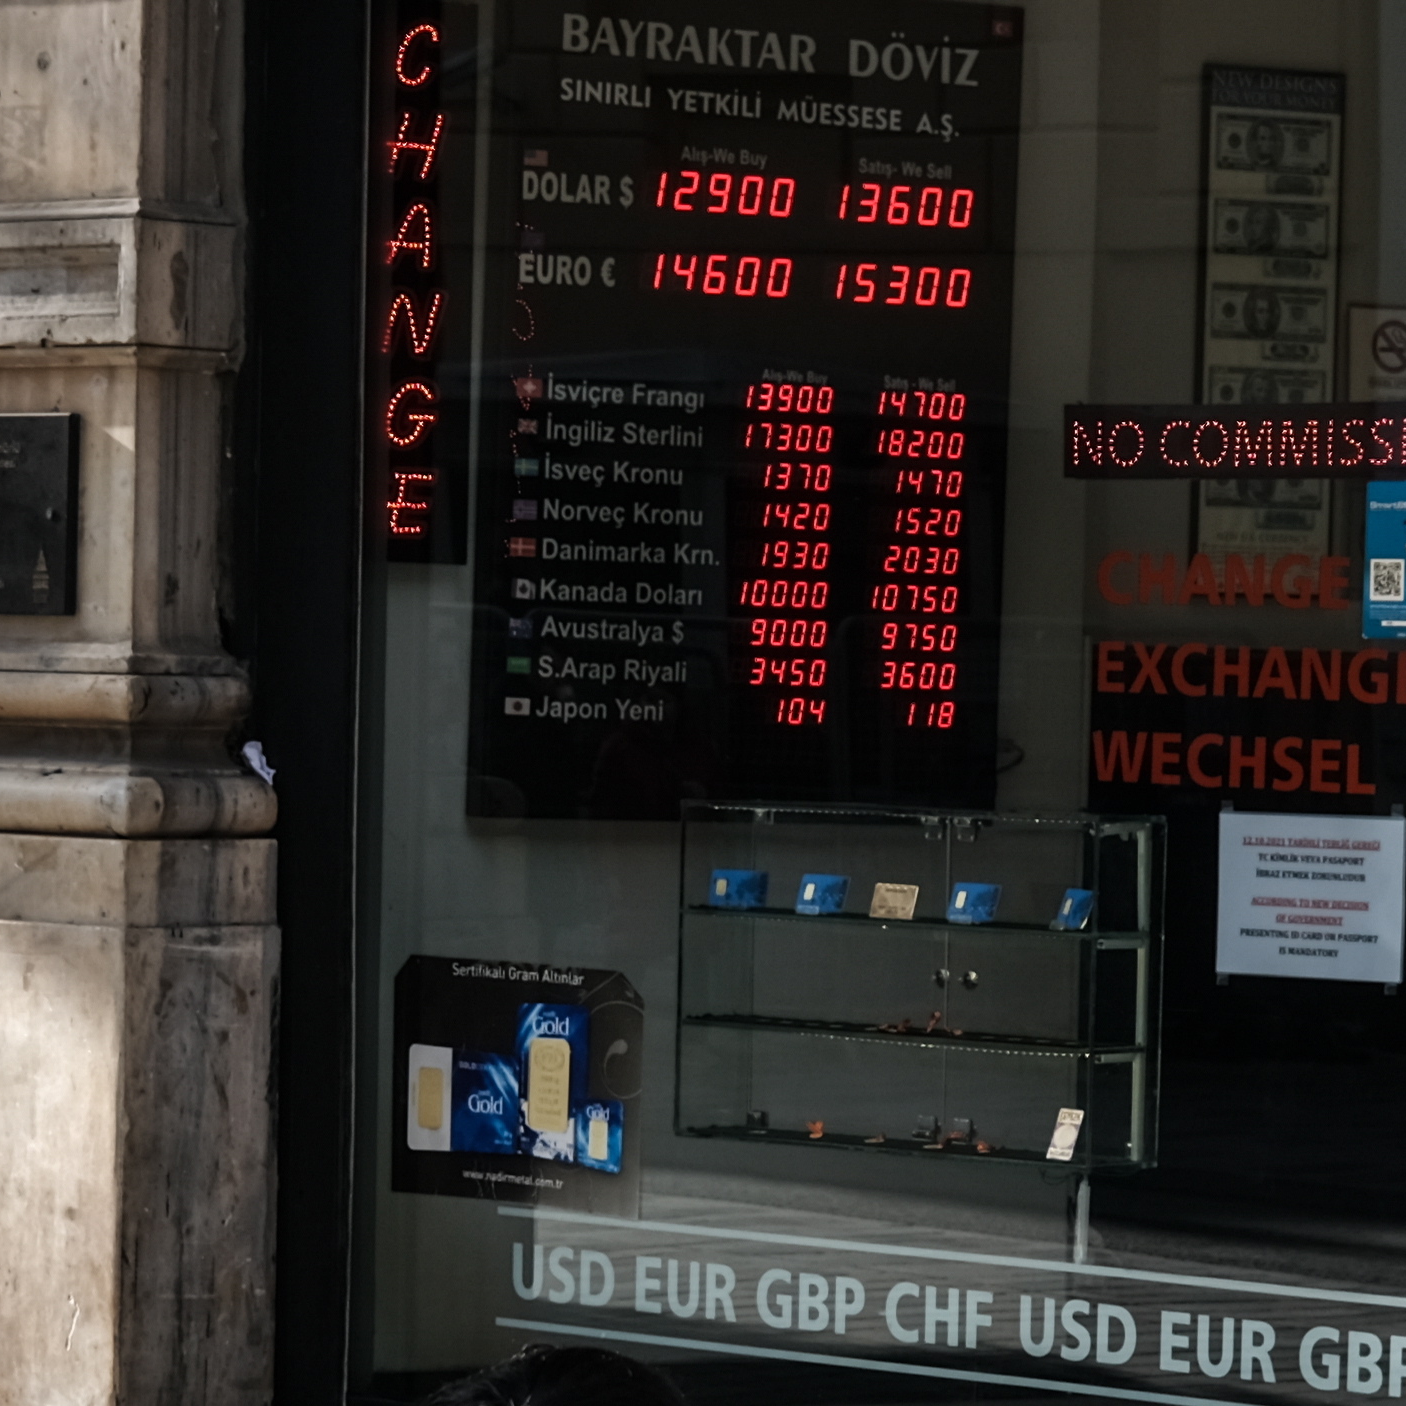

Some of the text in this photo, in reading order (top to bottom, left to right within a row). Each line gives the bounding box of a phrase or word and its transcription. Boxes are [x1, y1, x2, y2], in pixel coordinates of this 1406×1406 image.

[562, 13, 980, 87] BAYRAKTAR DÖVİZ
[560, 78, 960, 142] SINIRLI YETKİLİ MÜESSESE A.Ş.
[740, 149, 768, 170] Buy
[926, 161, 953, 180] Sell
[523, 170, 976, 229] DOLAR $ 12900 13600
[382, 22, 443, 536] CHANGE
[519, 253, 972, 309] EURO € 14600 15300
[548, 371, 966, 421] İsviçre Frangı 13900 14700
[546, 412, 964, 459] İngiliz Sterlini 17300 18200
[1072, 419, 1145, 467] NO
[545, 451, 962, 497] İsveç Kronu 1370 1470
[543, 498, 961, 536] Norveç Kronu 1420 1520
[542, 537, 959, 574] Danimarka Krn. 1930 2030
[540, 577, 957, 613] Kanada Doları 10000 10750
[1097, 550, 1351, 610] CHANGE
[541, 615, 956, 651] Avustralya $ 9000 9750
[538, 655, 956, 690] S.Arap Riyali 3450 3600
[536, 695, 955, 728] Japon Yeni 104 118
[1092, 729, 1376, 795] WECHSEL
[508, 966, 539, 981] Gram
[532, 1016, 569, 1036] Gold
[468, 1094, 503, 1115] Gold
[512, 1242, 616, 1307] USD
[634, 1255, 736, 1323] EUR
[756, 1268, 866, 1336] GBP
[885, 1280, 994, 1351] CHF
[1019, 1294, 1138, 1366] USD
[1160, 1308, 1276, 1384] EUR
